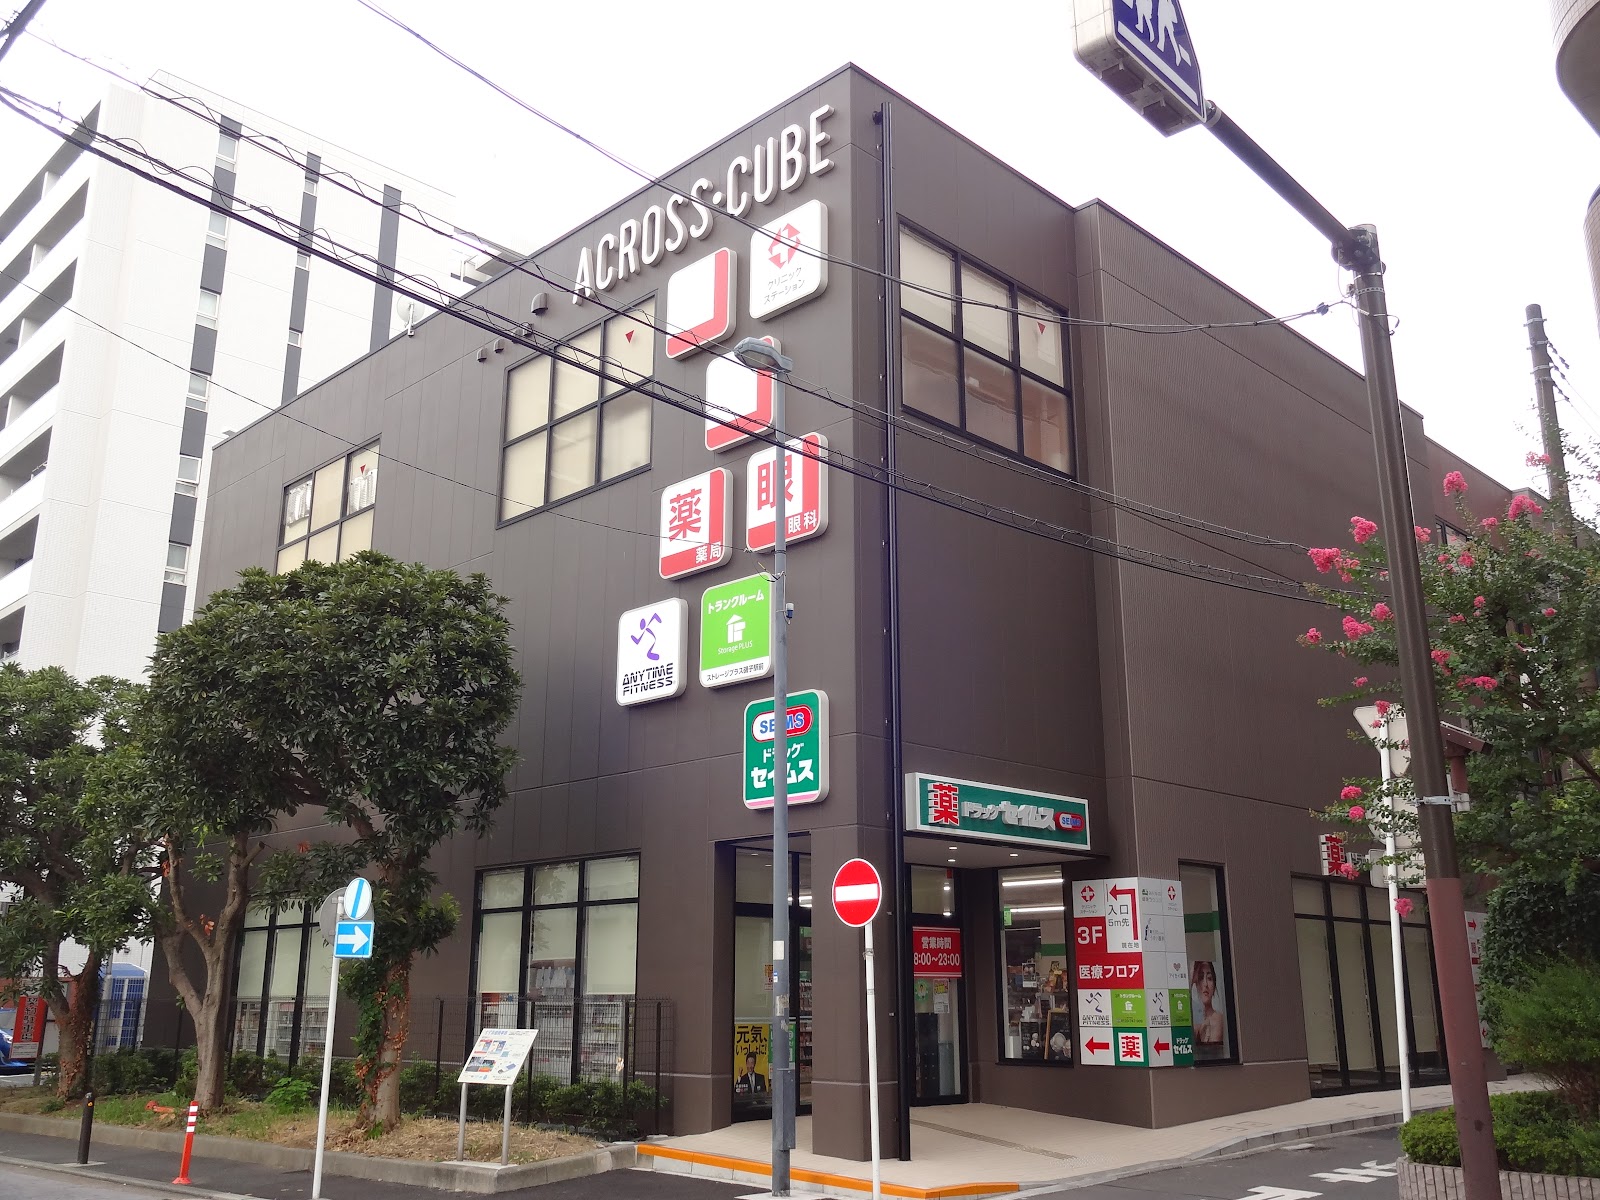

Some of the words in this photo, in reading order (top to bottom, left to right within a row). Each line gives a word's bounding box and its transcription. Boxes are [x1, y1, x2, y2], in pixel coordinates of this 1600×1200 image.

[767, 266, 802, 290] クリニック
[763, 279, 806, 305] ステーション
[668, 487, 702, 543] 薬
[787, 509, 818, 534] 眼科
[695, 540, 722, 564] 薬局
[707, 588, 765, 615] トランクルーム
[717, 644, 739, 656] Storage
[738, 639, 753, 650] PLUS
[622, 662, 673, 686] ANYTIME
[622, 675, 673, 696] FITNESS
[759, 712, 805, 735] SEMS
[930, 782, 960, 827] 薬
[1107, 904, 1129, 915] 入口
[1108, 918, 1130, 927] 5m先
[920, 936, 952, 950] 営業時間
[1077, 925, 1103, 945] 3F
[1078, 964, 1140, 980] 医療フロア
[1121, 1035, 1141, 1058] 薬
[1173, 1044, 1193, 1055] セイムス
